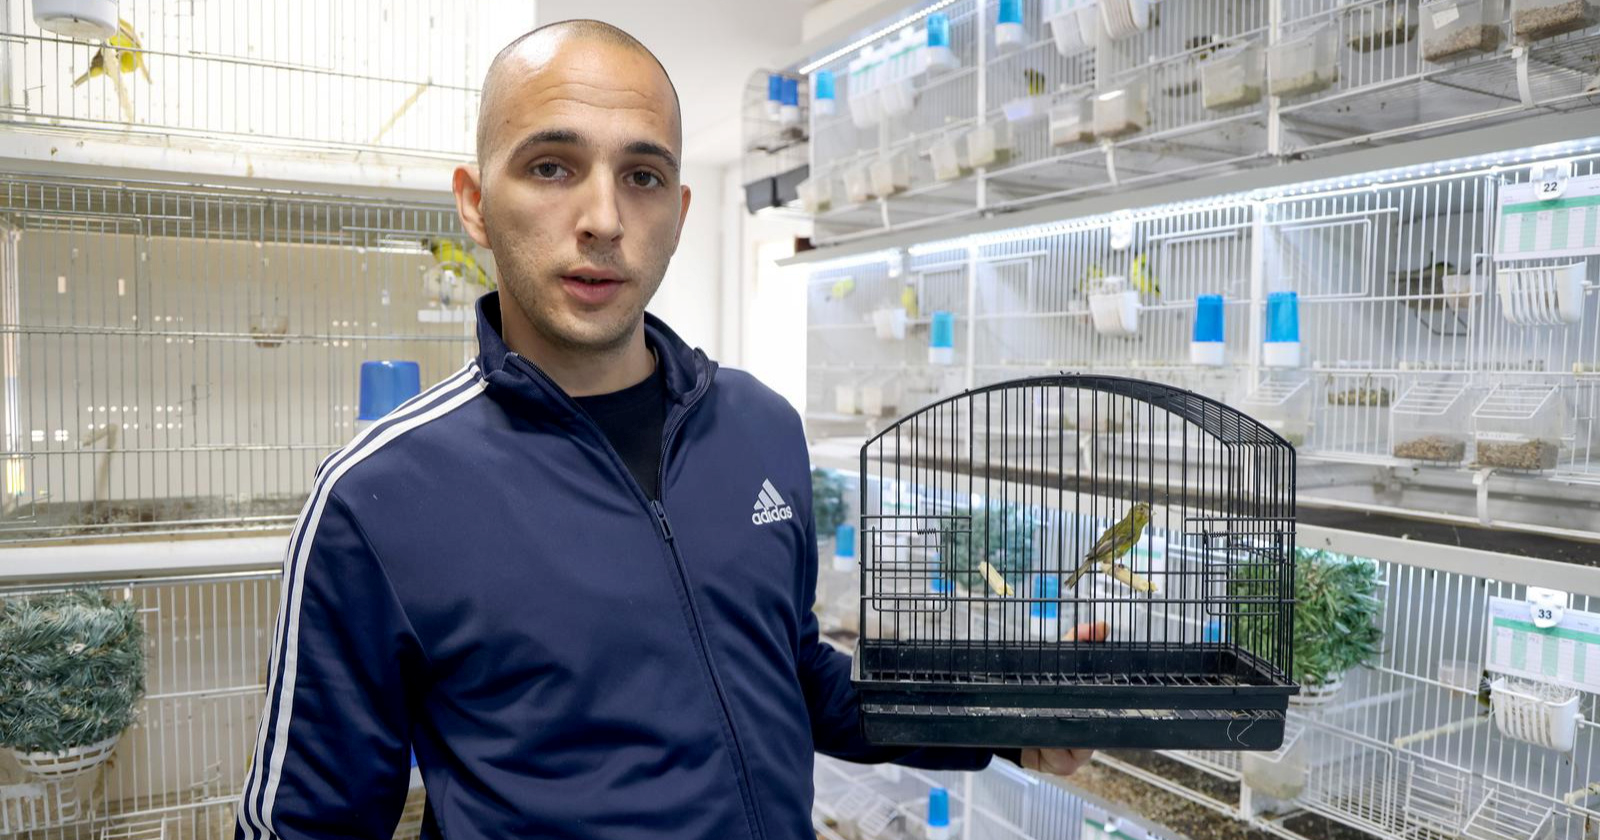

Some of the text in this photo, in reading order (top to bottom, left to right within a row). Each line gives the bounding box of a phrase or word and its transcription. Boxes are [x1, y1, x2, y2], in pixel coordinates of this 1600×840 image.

[1543, 181, 1558, 192] 22
[752, 505, 793, 525] adidas
[1538, 608, 1552, 620] 33
